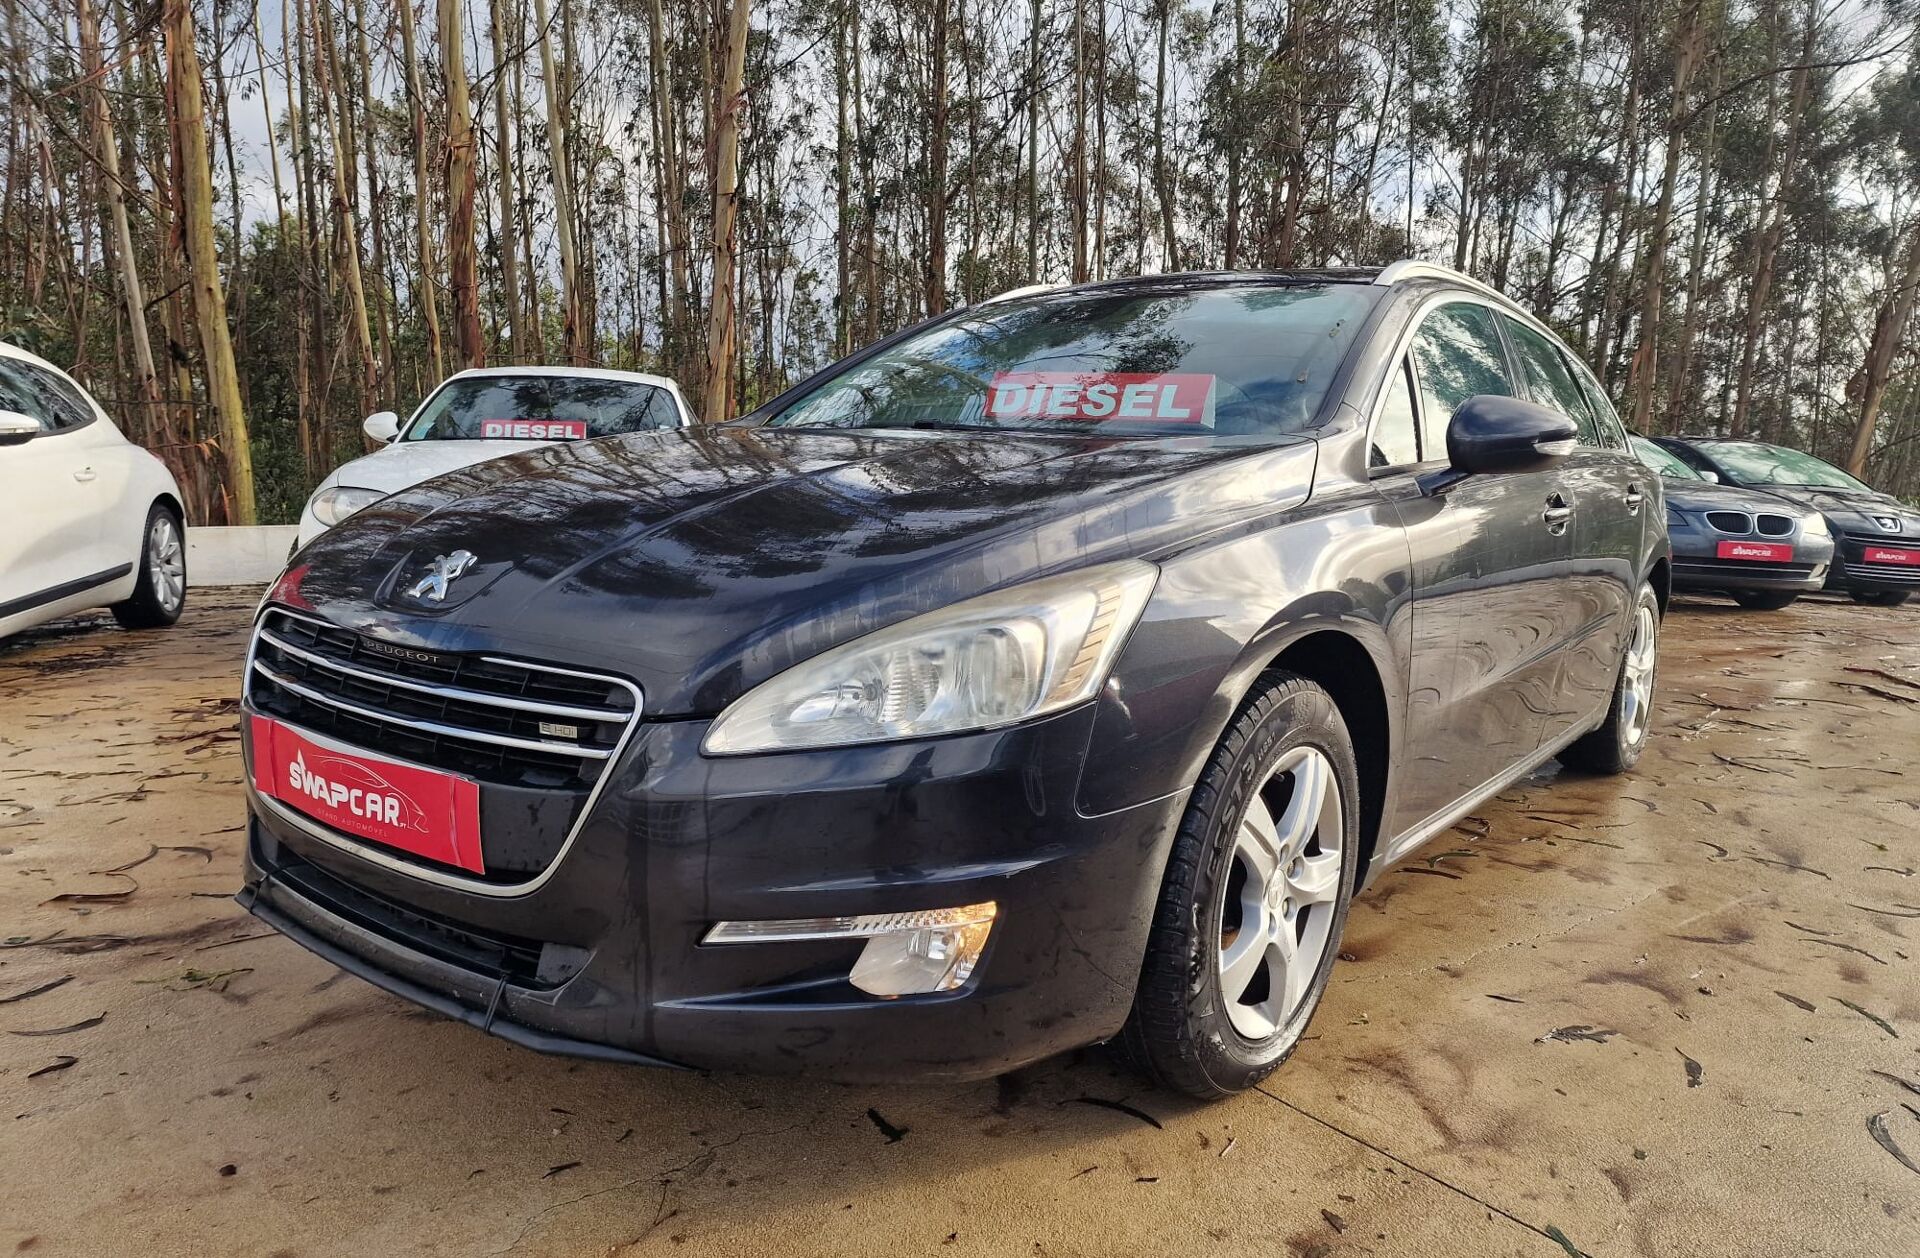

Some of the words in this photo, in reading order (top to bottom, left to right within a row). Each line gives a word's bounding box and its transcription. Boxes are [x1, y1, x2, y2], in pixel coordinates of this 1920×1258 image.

[991, 383, 1190, 418] DIESEL
[485, 423, 580, 439] DIESEL
[366, 641, 439, 663] PEUGEOT
[289, 748, 399, 827] SWAPCAR
